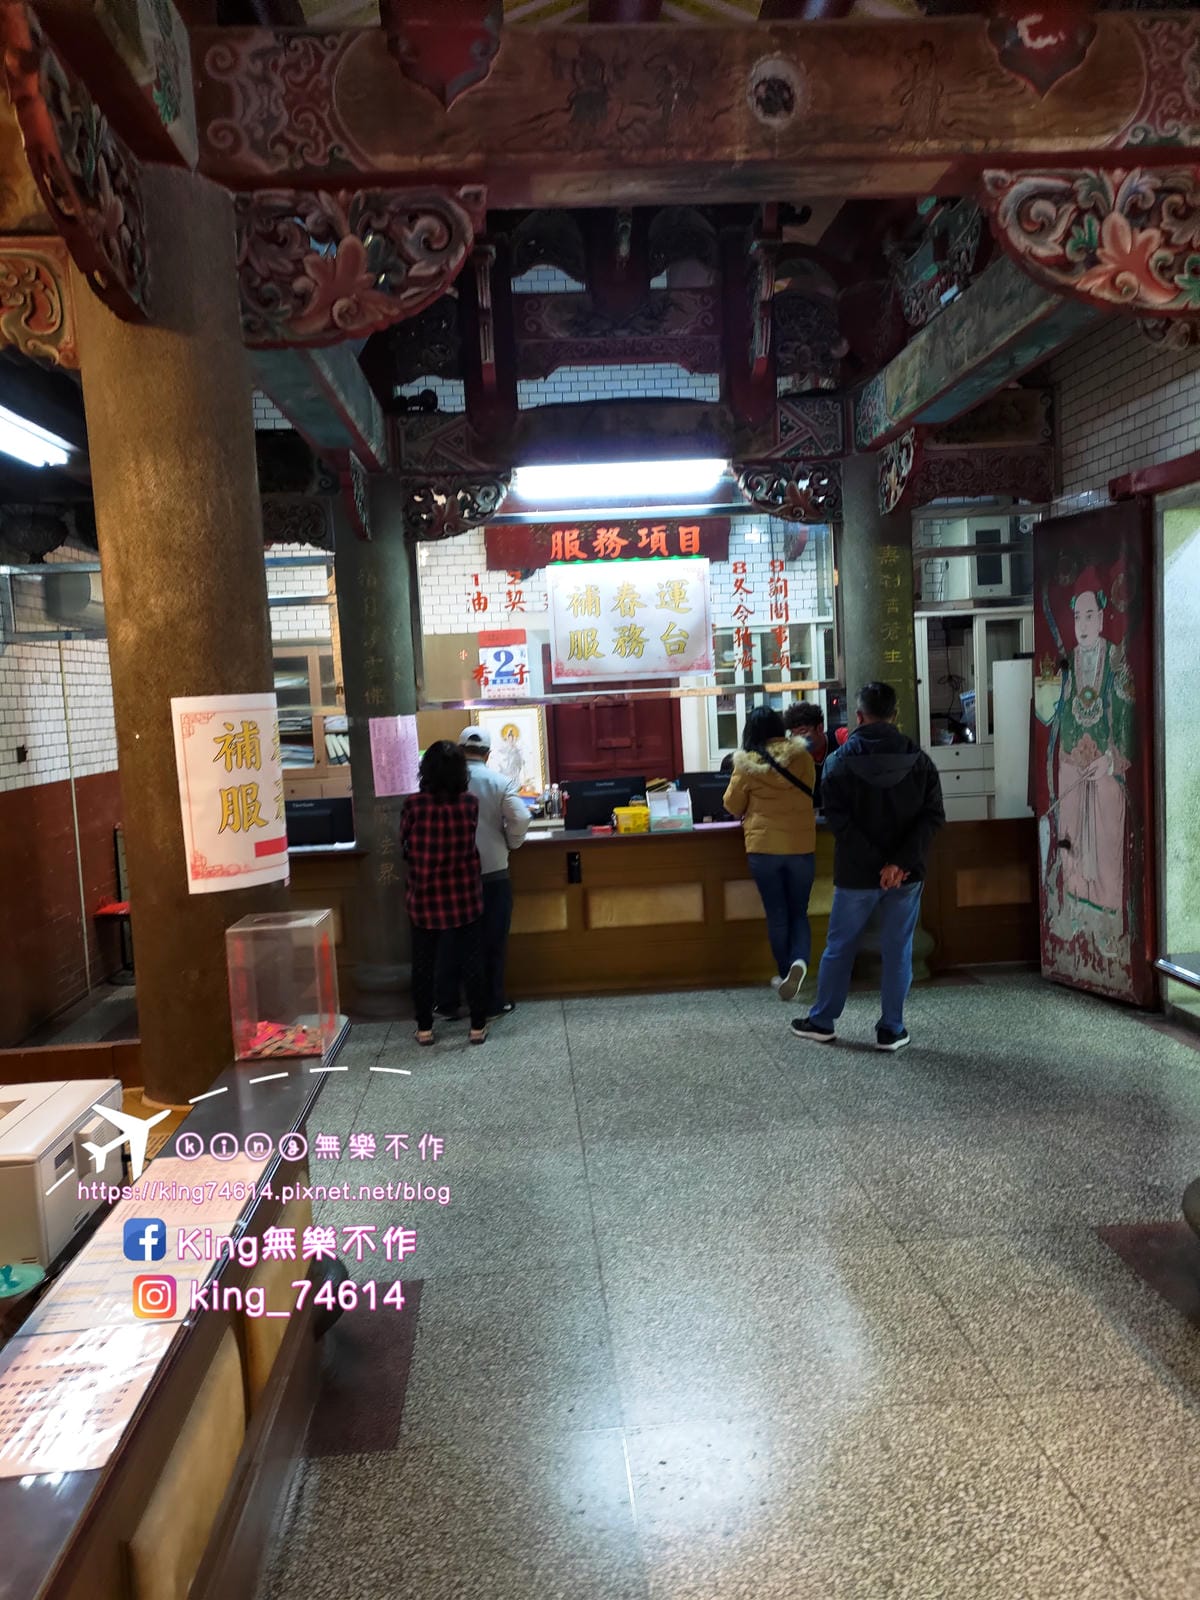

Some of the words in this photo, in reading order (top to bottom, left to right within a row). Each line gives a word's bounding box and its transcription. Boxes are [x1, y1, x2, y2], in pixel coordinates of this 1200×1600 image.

[549, 525, 701, 560] 服務項目
[566, 579, 691, 620] 補春運
[566, 622, 690, 661] 服務台
[493, 650, 515, 679] 2
[212, 719, 284, 773] 補
[217, 777, 285, 835] 服
